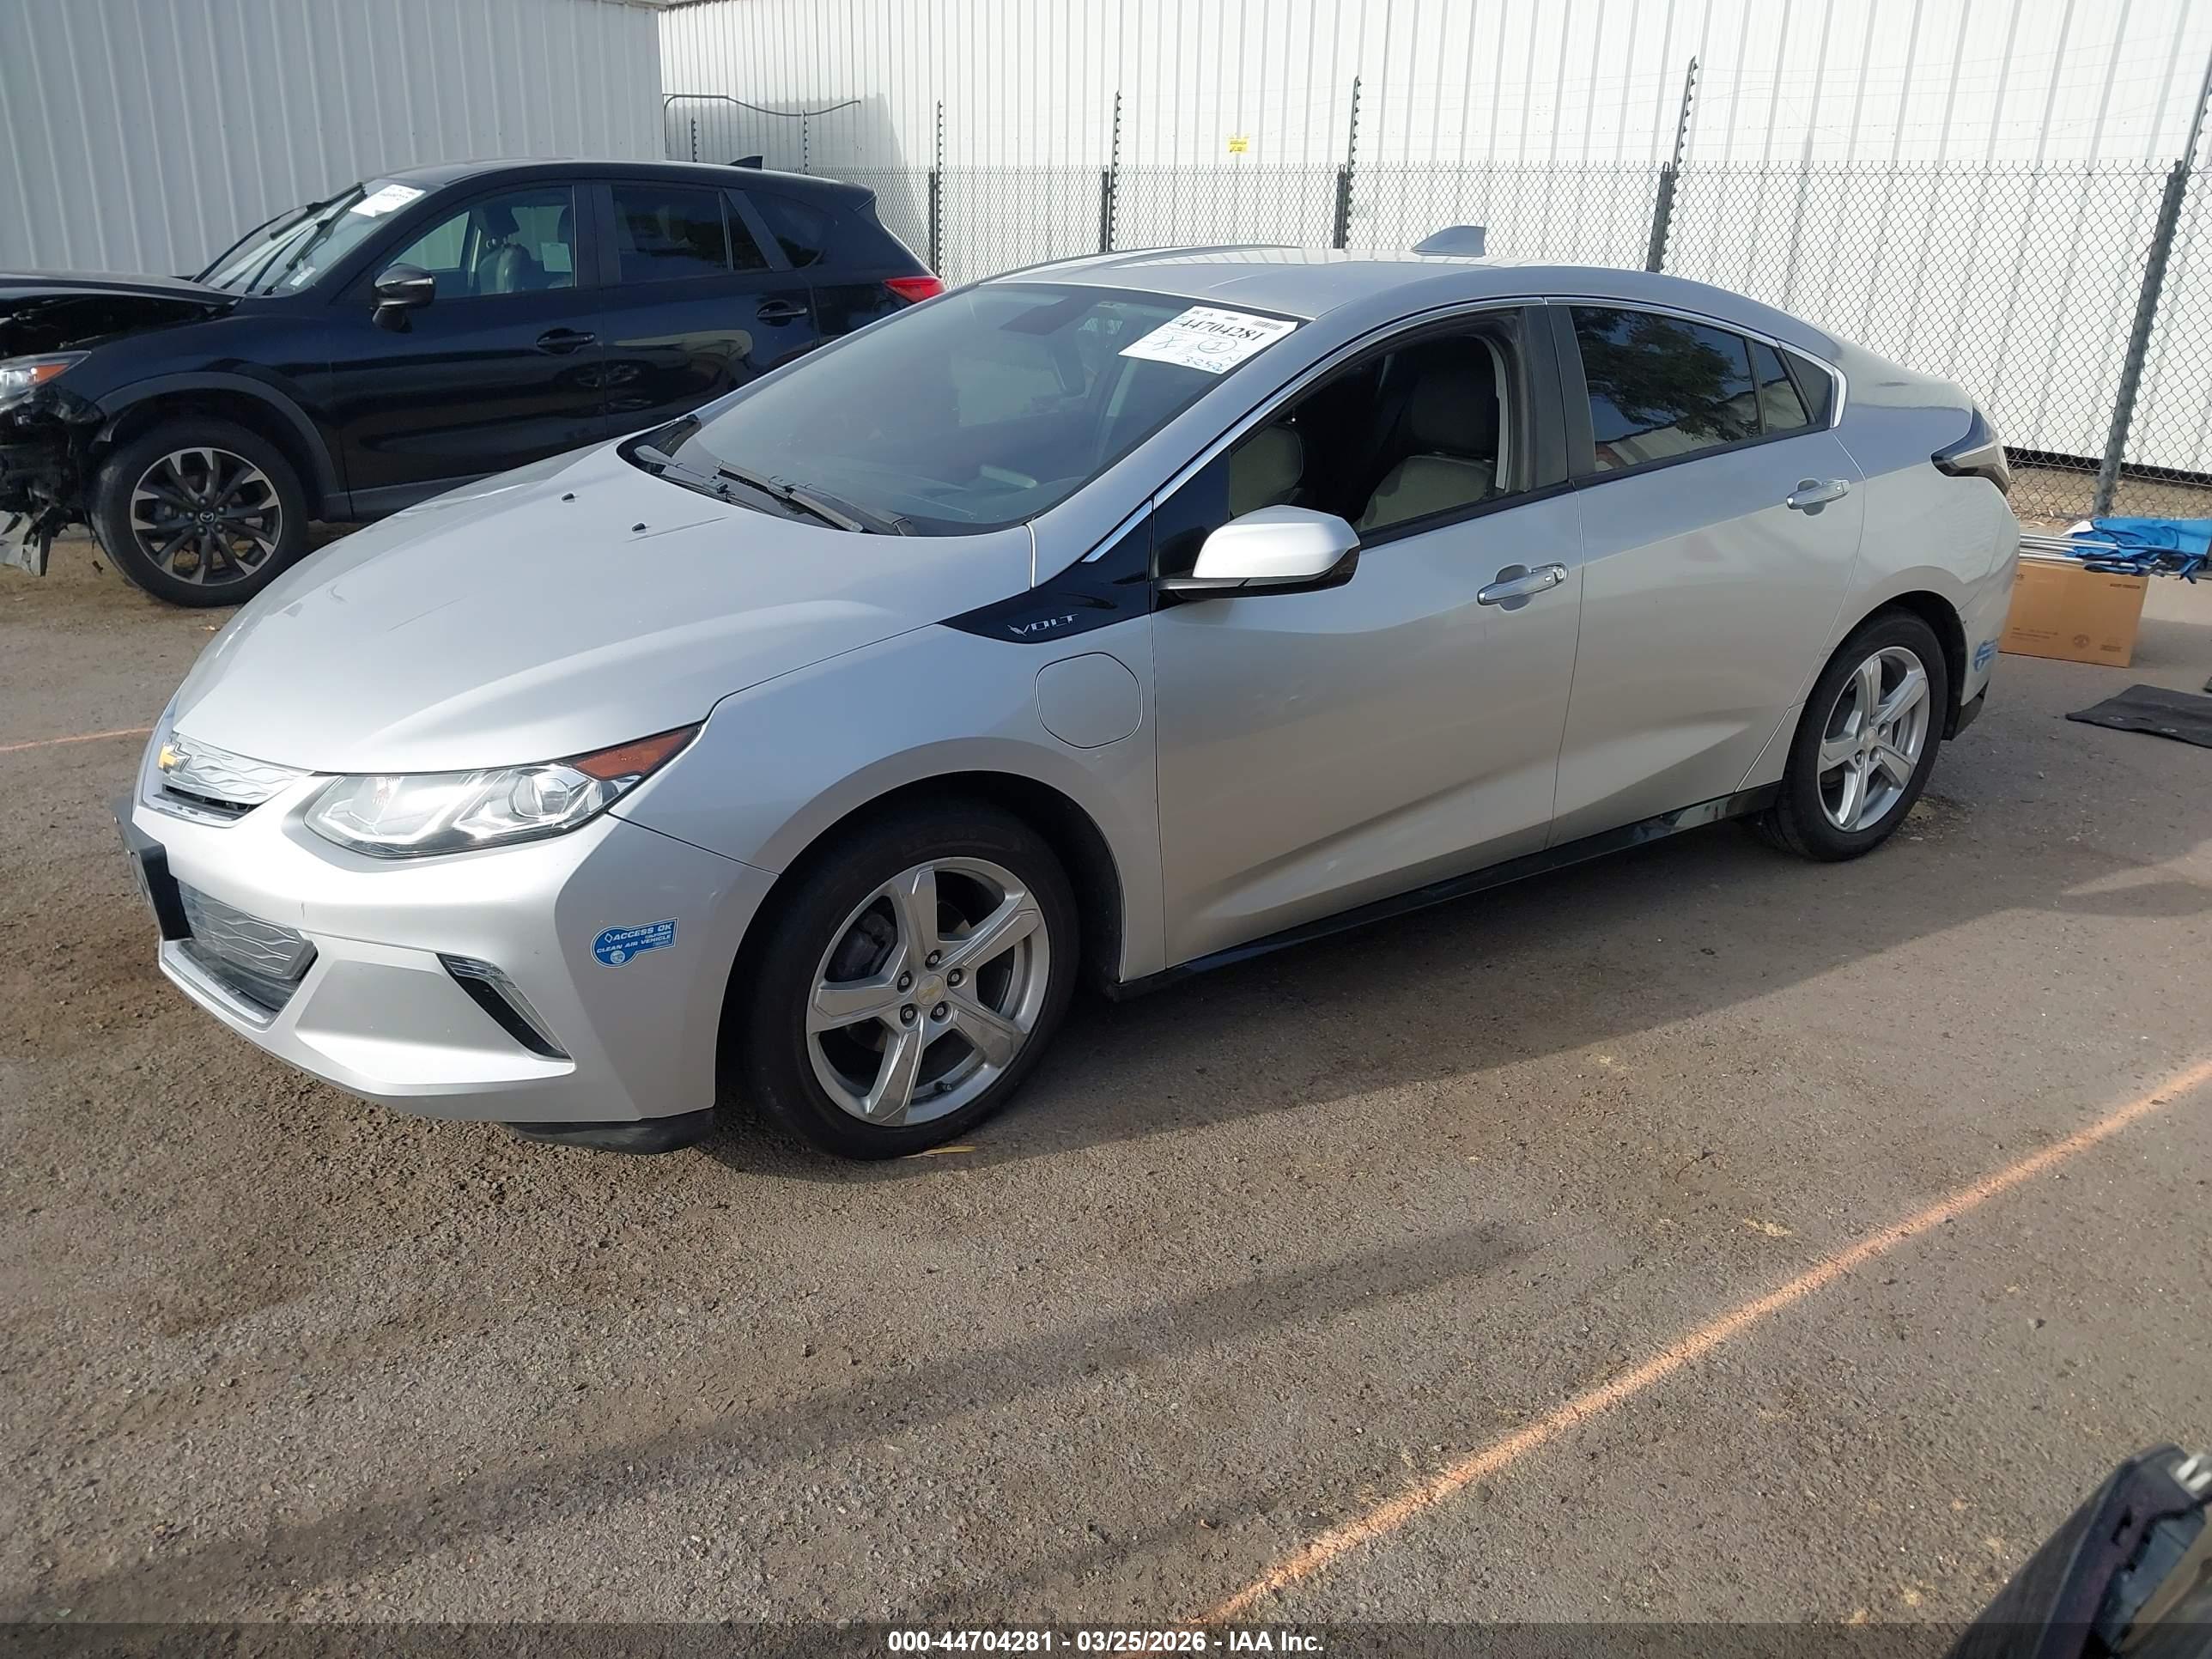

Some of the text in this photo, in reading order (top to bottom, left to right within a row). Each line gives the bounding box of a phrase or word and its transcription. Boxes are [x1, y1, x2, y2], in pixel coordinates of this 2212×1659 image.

[1181, 319, 1266, 341] 44704281
[1007, 614, 1079, 636] VOLT
[613, 923, 673, 941] ACCESS OK
[596, 944, 623, 953] CLEAN
[641, 934, 672, 945] VEHICLE
